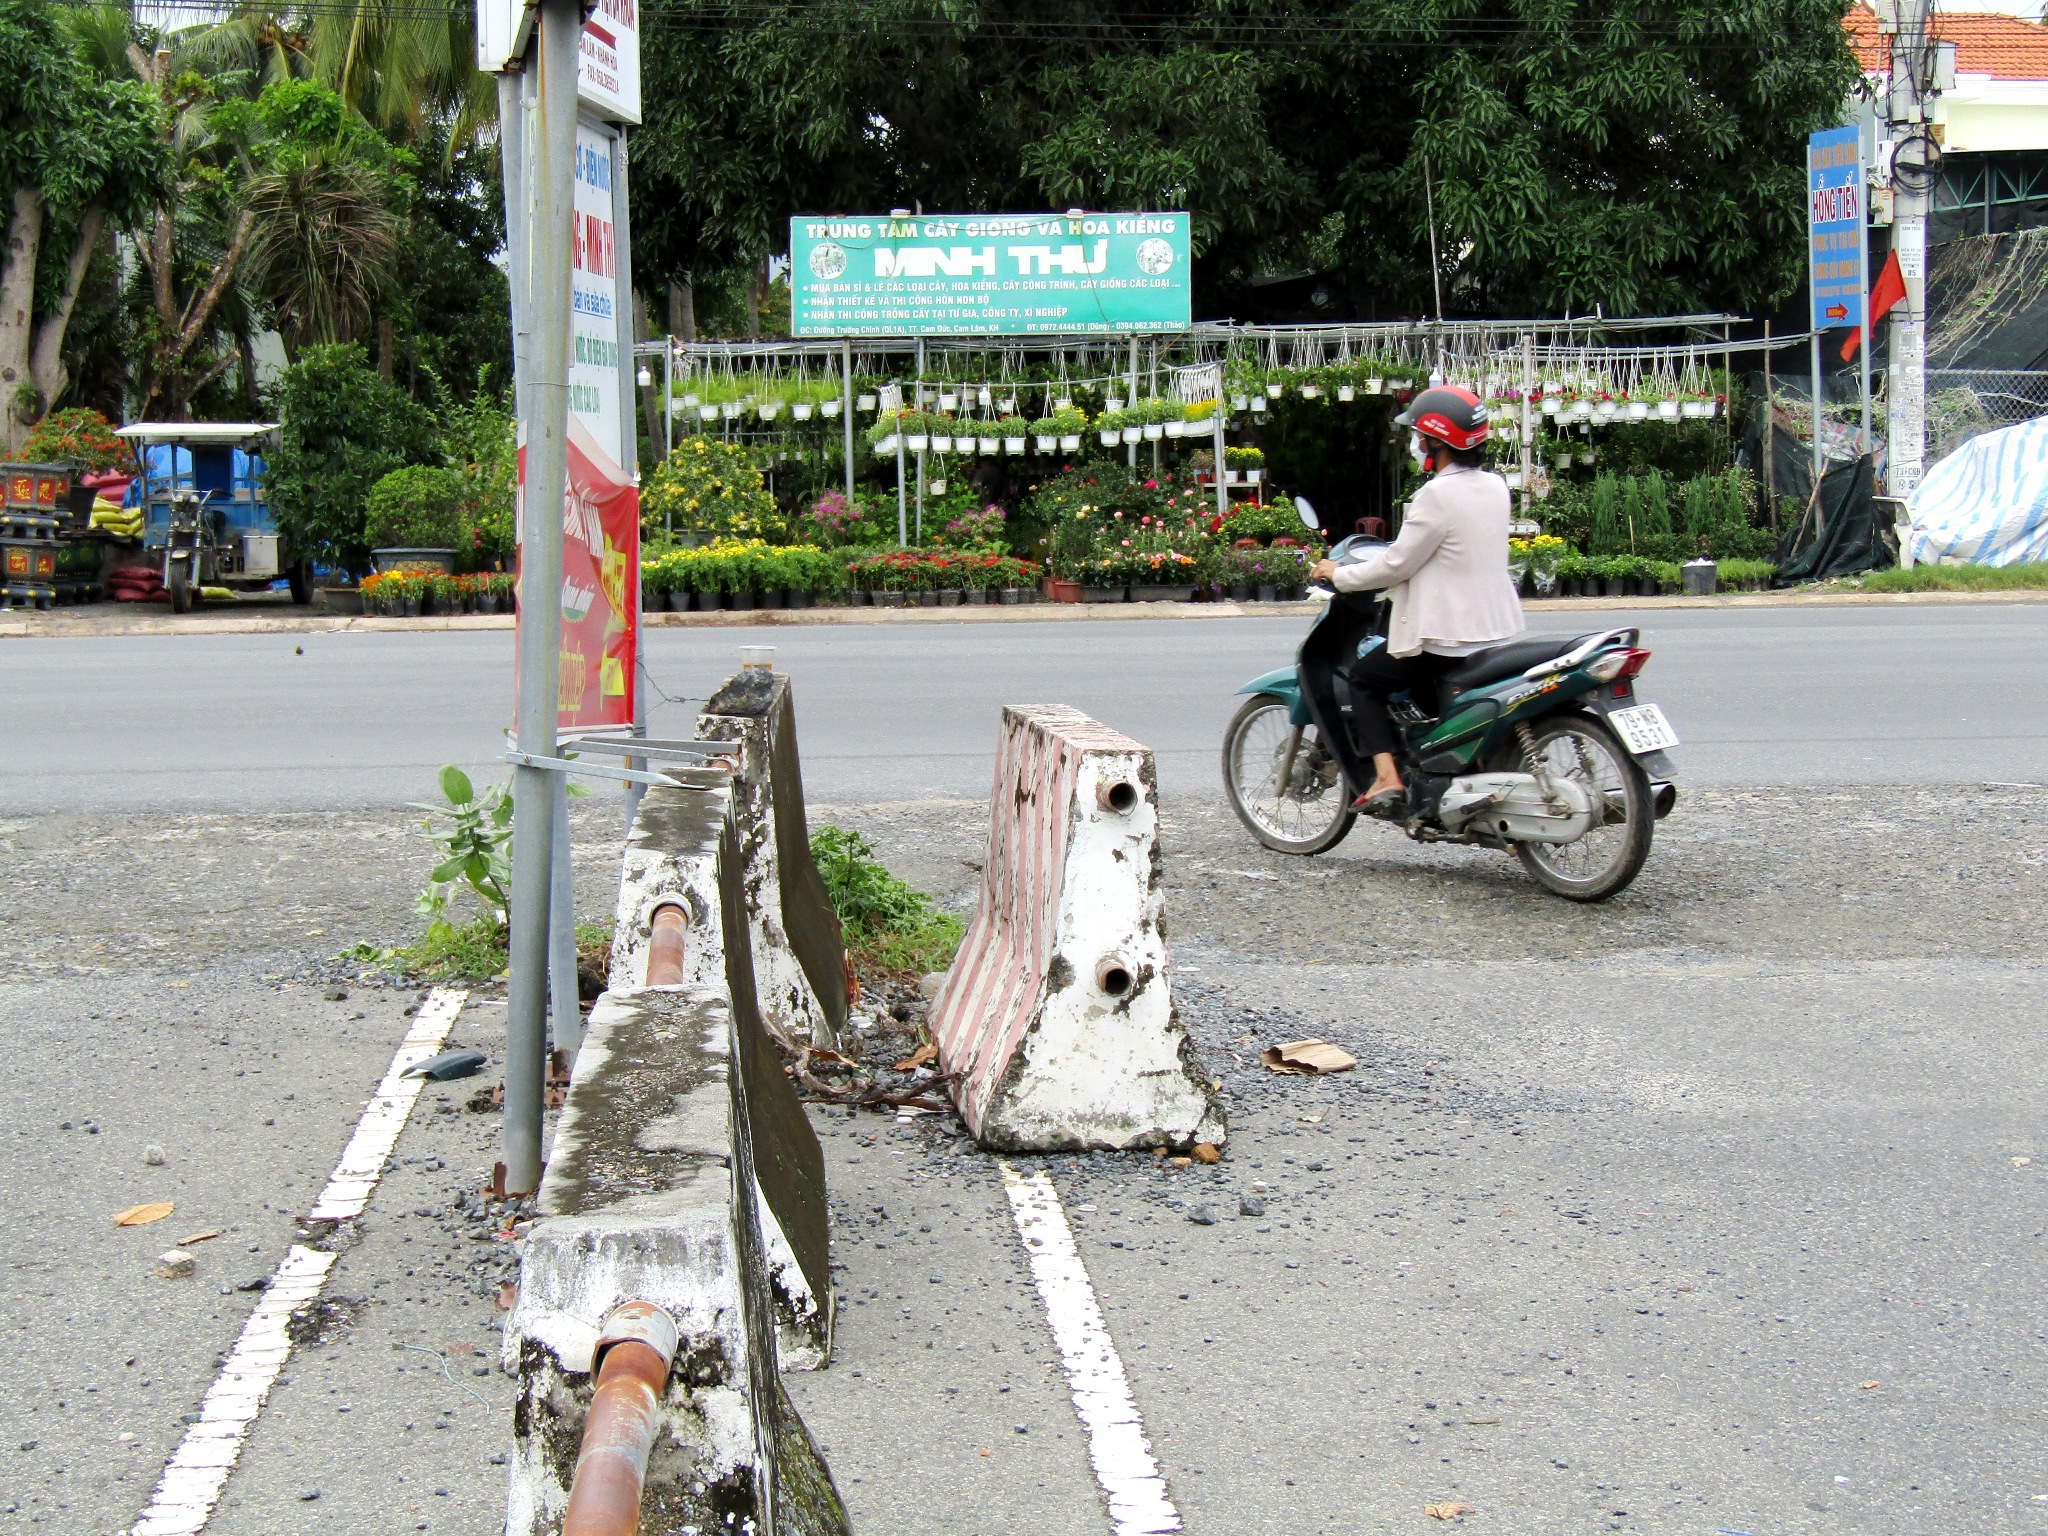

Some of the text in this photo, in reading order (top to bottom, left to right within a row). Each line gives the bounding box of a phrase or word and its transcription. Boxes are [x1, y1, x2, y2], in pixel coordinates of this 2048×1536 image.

[1813, 170, 1858, 224] HỒNG TIẾN
[806, 223, 872, 239] TRUNG
[877, 220, 918, 238] TÂM
[924, 220, 960, 238] CÂY
[965, 218, 1031, 237] GIỐNG
[1037, 219, 1063, 236] VÀ
[1069, 220, 1110, 236] HOA
[875, 239, 1108, 277] MINH THƯ
[811, 283, 831, 293] MUA
[833, 281, 851, 292] BÁN
[864, 283, 872, 292] &
[886, 280, 905, 292] CÁC
[907, 281, 926, 293] LOẠI
[929, 281, 949, 293] CÂY,
[951, 281, 969, 291] HOA
[1003, 280, 1020, 290] CÂY
[1022, 279, 1046, 290] CÔNG
[1081, 279, 1097, 289] CÂY
[1100, 277, 1127, 289] GIỐNG
[1129, 277, 1147, 288] CÁC
[1150, 278, 1170, 290] LOẠI
[811, 295, 835, 306] NHẬN
[837, 294, 862, 306] THIẾT
[864, 294, 876, 305] KẾ
[892, 296, 906, 305] THI
[909, 294, 933, 305] CÔNG
[935, 294, 954, 305] HÒN
[956, 296, 975, 304] NON
[977, 294, 990, 306] BỘ
[811, 309, 835, 320] NHẬN
[837, 310, 852, 319] THI
[854, 308, 879, 320] CÔNG
[881, 307, 910, 319] TRỒNG
[913, 308, 930, 319] CÂY
[932, 310, 946, 320] TẠI
[949, 309, 960, 318] TƯ
[962, 309, 980, 320] GIA,
[982, 307, 1006, 319] CÔNG
[1009, 308, 1022, 318] TY,
[1035, 307, 1068, 319] NGHIỆP
[920, 325, 935, 333] Cam
[954, 325, 969, 333] Cam
[989, 324, 999, 332] KH
[1630, 726, 1669, 749] 9531
